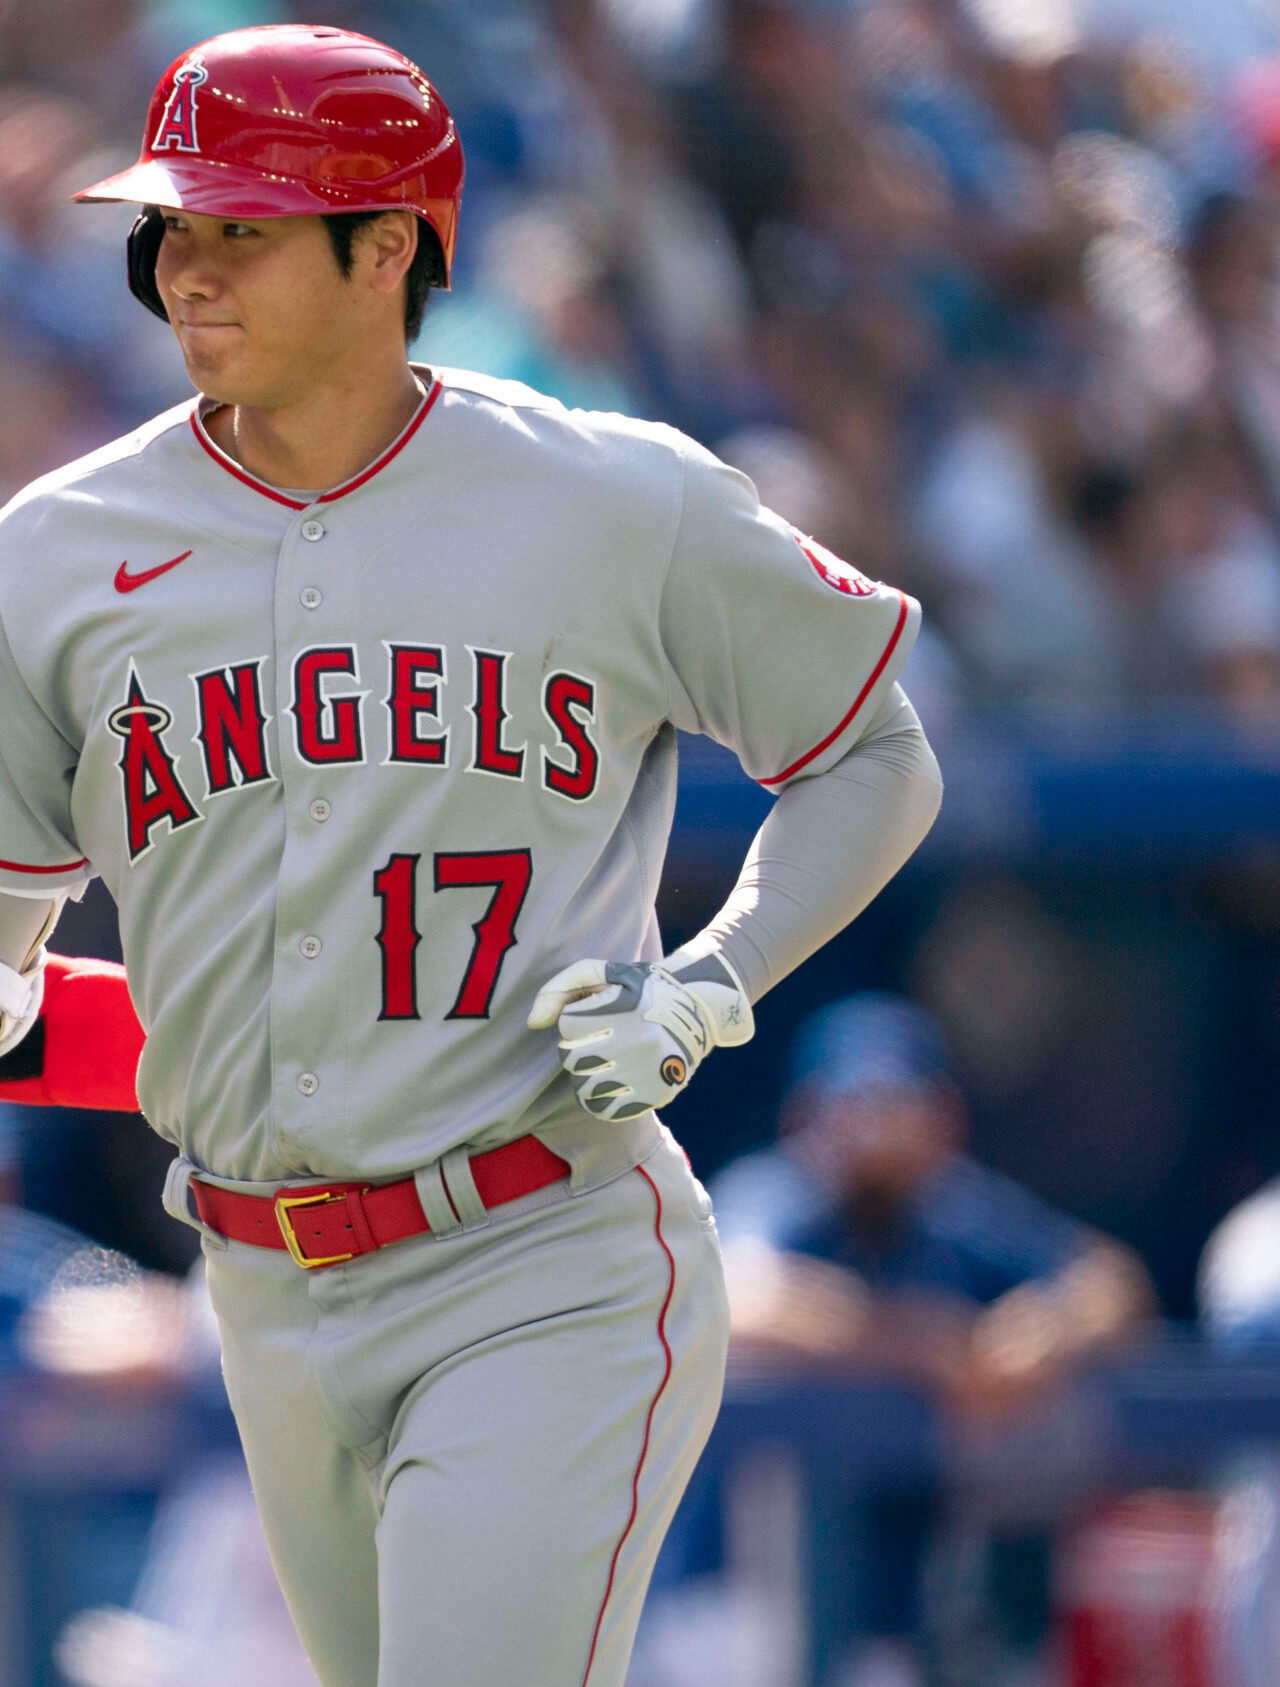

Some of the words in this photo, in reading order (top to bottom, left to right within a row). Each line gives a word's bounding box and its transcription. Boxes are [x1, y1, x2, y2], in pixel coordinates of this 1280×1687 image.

[151, 53, 209, 153] A
[105, 640, 601, 867] ANGELS
[373, 847, 532, 1022] 17
